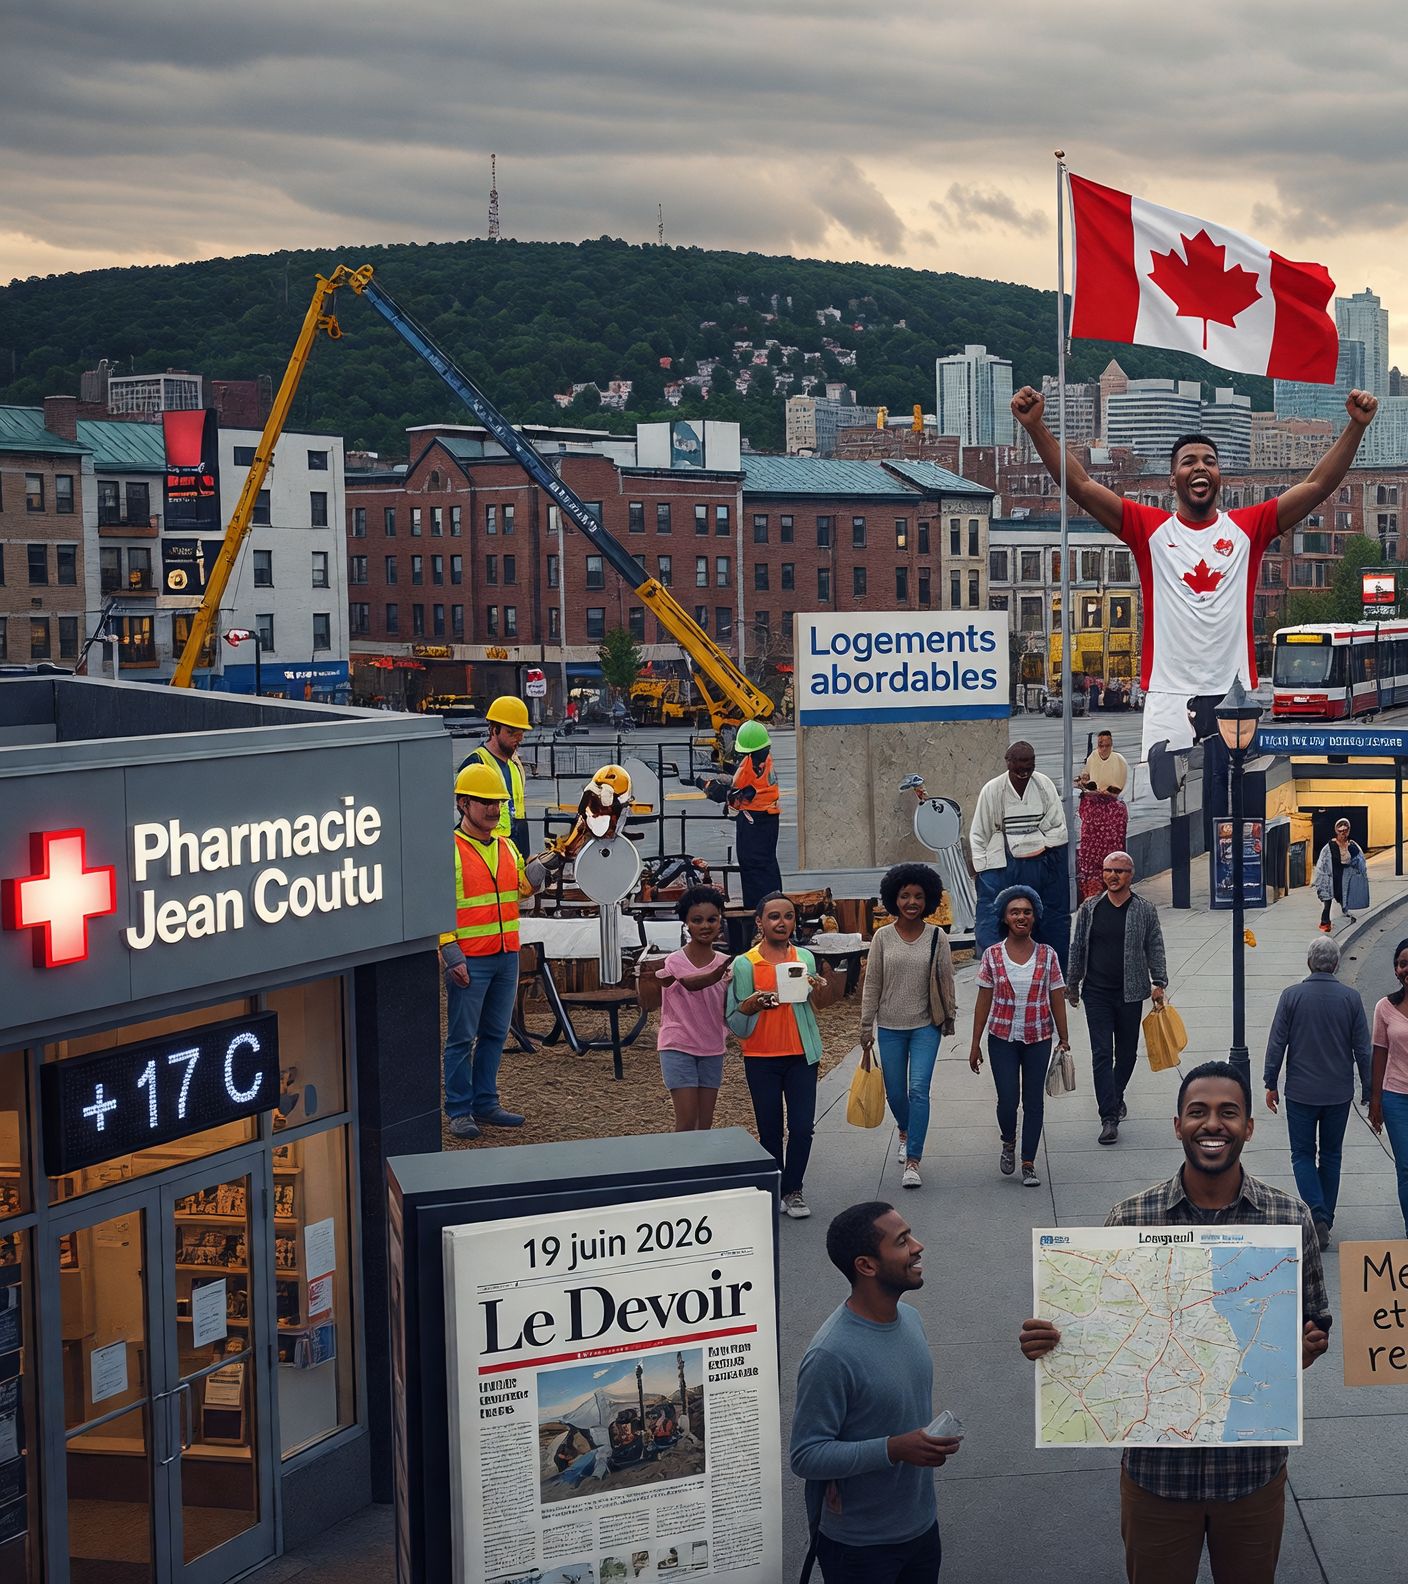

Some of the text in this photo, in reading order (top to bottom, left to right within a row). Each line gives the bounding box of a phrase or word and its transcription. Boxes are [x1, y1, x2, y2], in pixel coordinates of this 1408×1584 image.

[810, 623, 998, 664] Logements
[809, 658, 999, 696] abordables
[132, 795, 383, 883] Pharmacie
[126, 857, 384, 952] Jean Coutu
[222, 1031, 263, 1104] C
[522, 1214, 714, 1271] 19 juin 2026
[478, 1268, 753, 1356] Le Devoir
[1371, 1298, 1408, 1330] et
